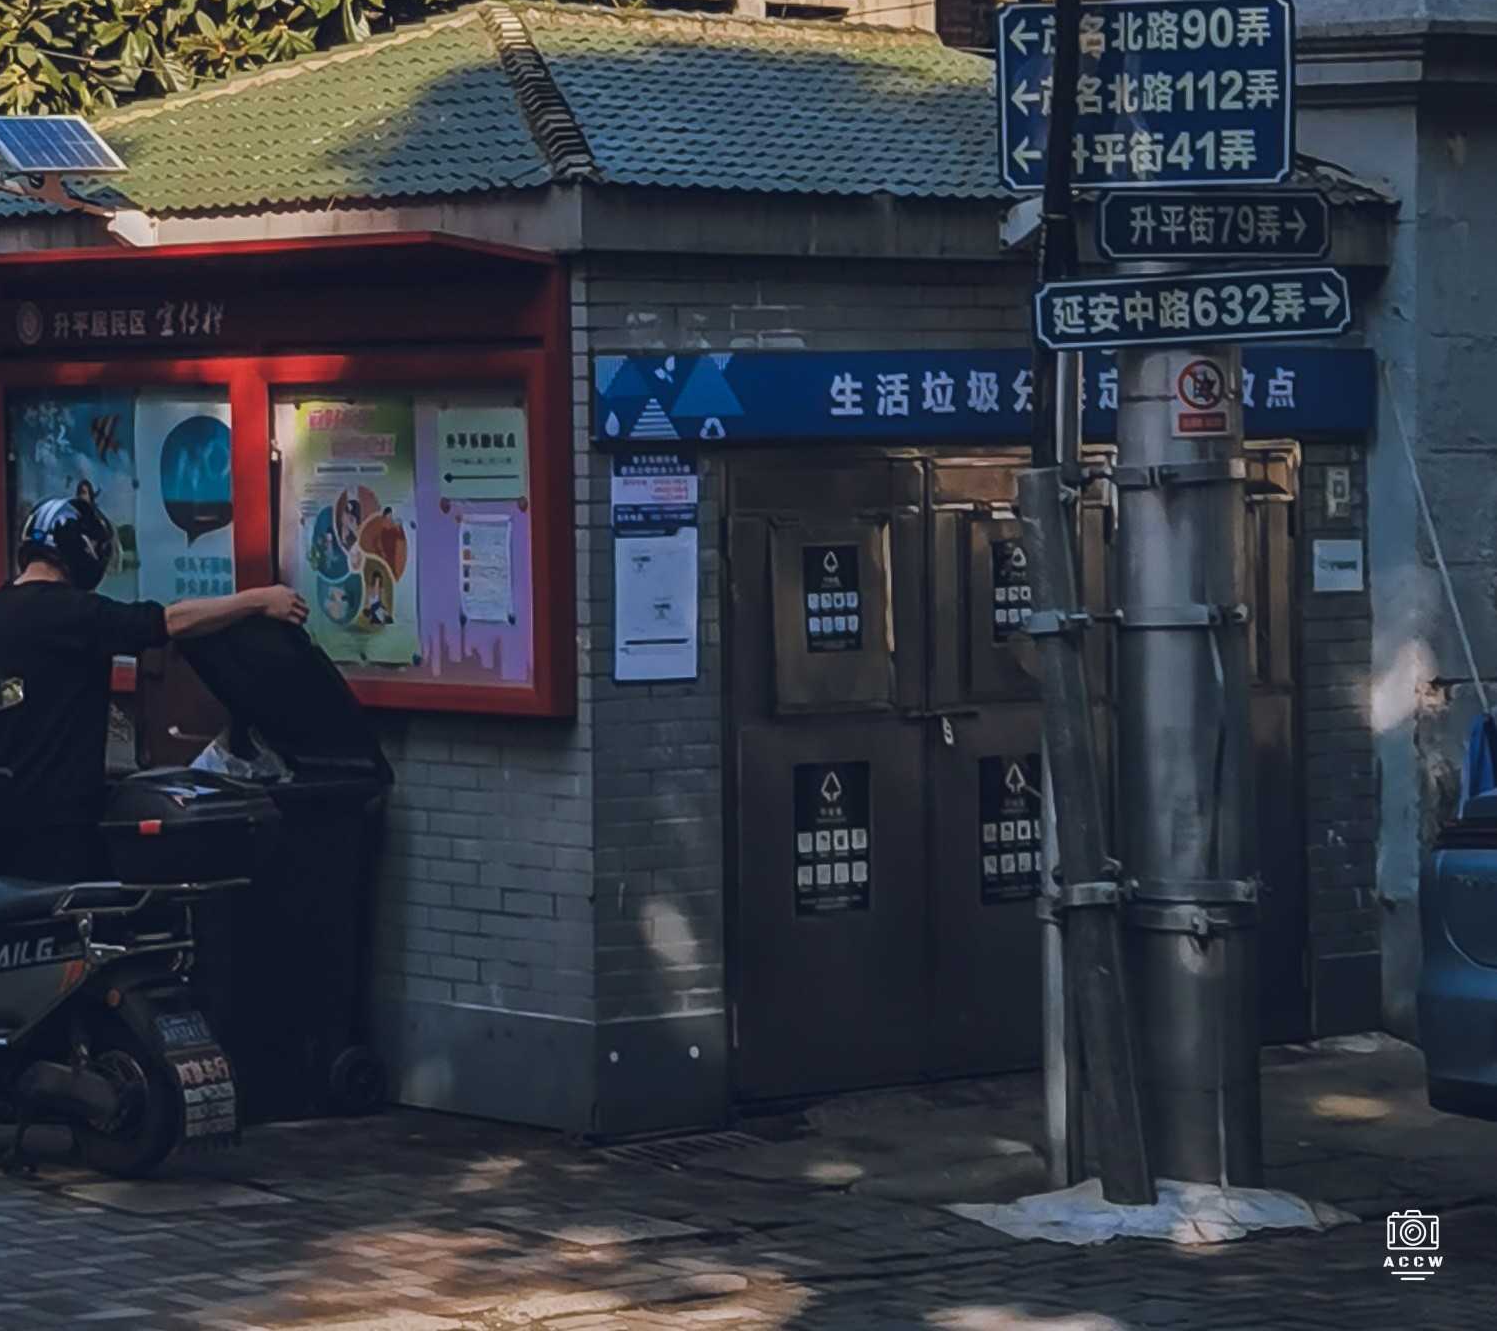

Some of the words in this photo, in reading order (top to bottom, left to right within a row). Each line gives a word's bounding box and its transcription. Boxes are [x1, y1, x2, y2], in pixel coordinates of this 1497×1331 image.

[1128, 204, 1282, 245] 升平街79弄
[1051, 282, 1305, 335] 延安中路632弄
